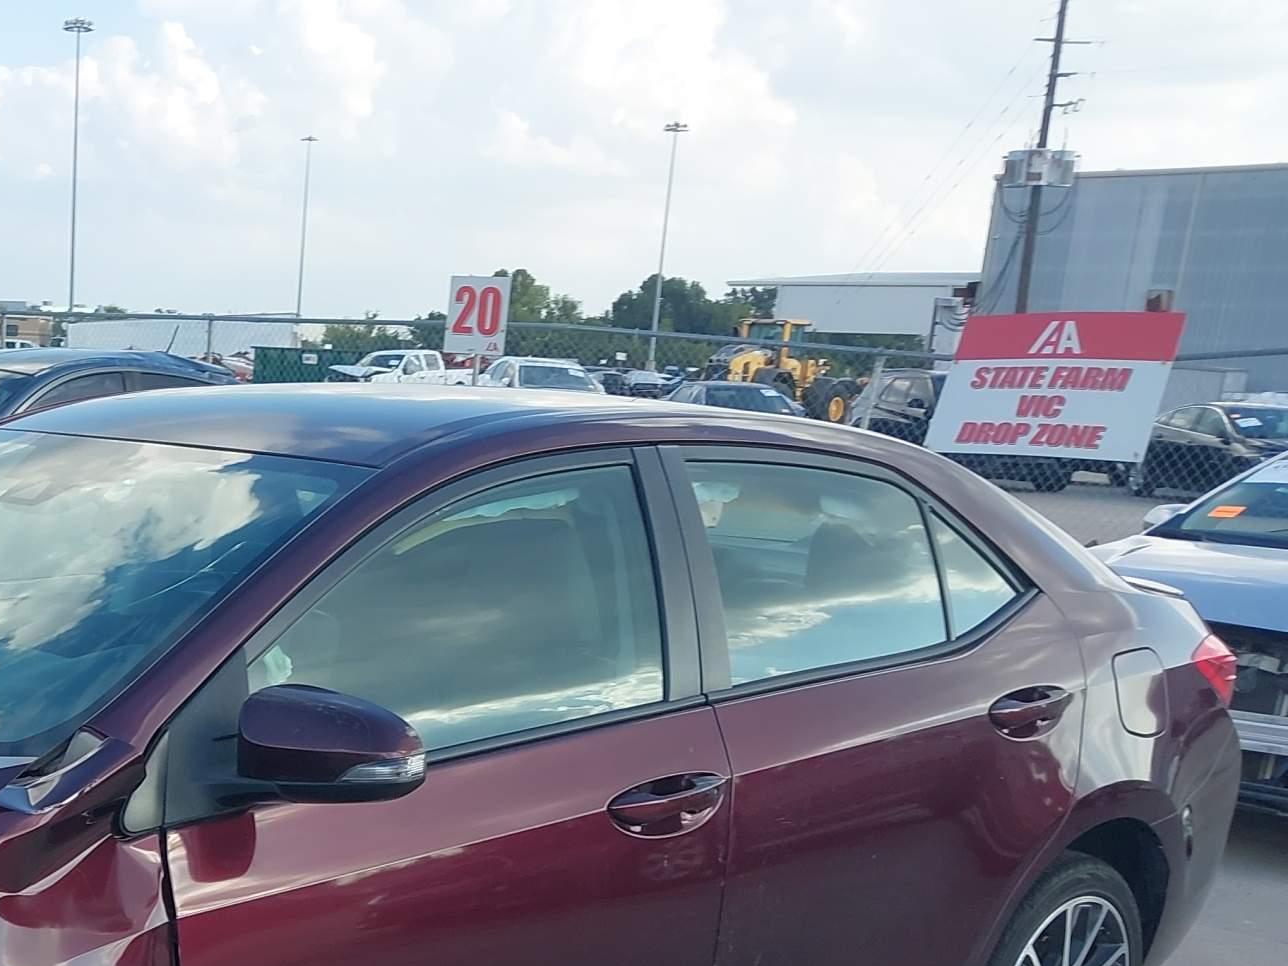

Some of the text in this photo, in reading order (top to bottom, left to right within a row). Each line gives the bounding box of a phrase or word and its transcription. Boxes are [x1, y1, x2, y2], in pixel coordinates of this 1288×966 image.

[451, 285, 502, 337] 20
[970, 366, 1133, 392] STATE FARM
[1015, 395, 1066, 418] VIC
[955, 422, 1107, 449] DROP ZONE
